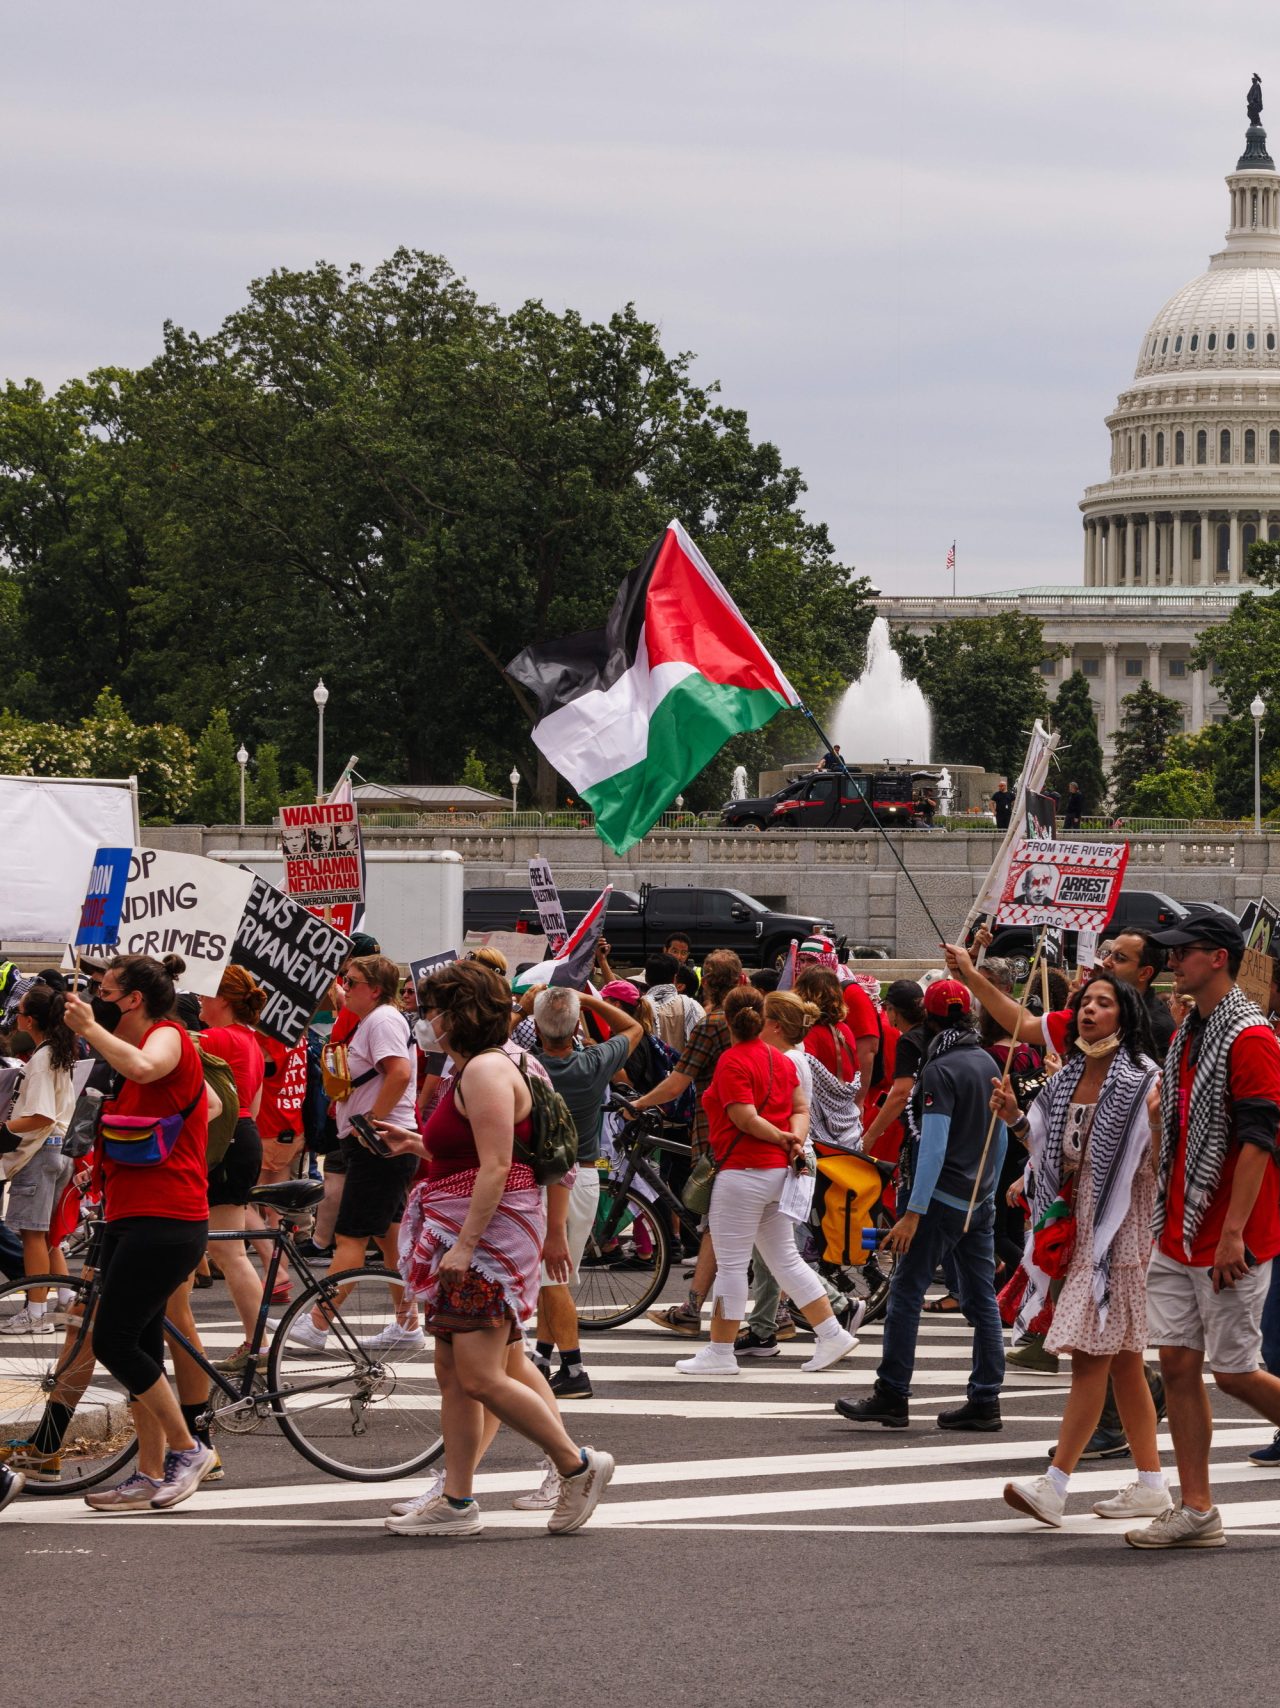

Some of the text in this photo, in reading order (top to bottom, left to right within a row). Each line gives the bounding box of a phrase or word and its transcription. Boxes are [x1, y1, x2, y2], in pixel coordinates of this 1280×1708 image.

[282, 803, 354, 826] WANTED
[286, 850, 357, 861] WAR CRIMINAL
[1026, 841, 1114, 857] FROM THE RIVER
[126, 850, 156, 882] OP
[287, 857, 358, 877] BENJAMIN
[288, 873, 360, 893] NETANYAHU
[1060, 876, 1110, 893] ARREST
[121, 882, 198, 924] NDING
[1057, 891, 1106, 904] NETANYAHU!
[247, 878, 350, 971] EWS FOR
[128, 929, 227, 961] CRIMES
[234, 912, 336, 1000] RMANENT
[277, 1098, 303, 1109] ISR
